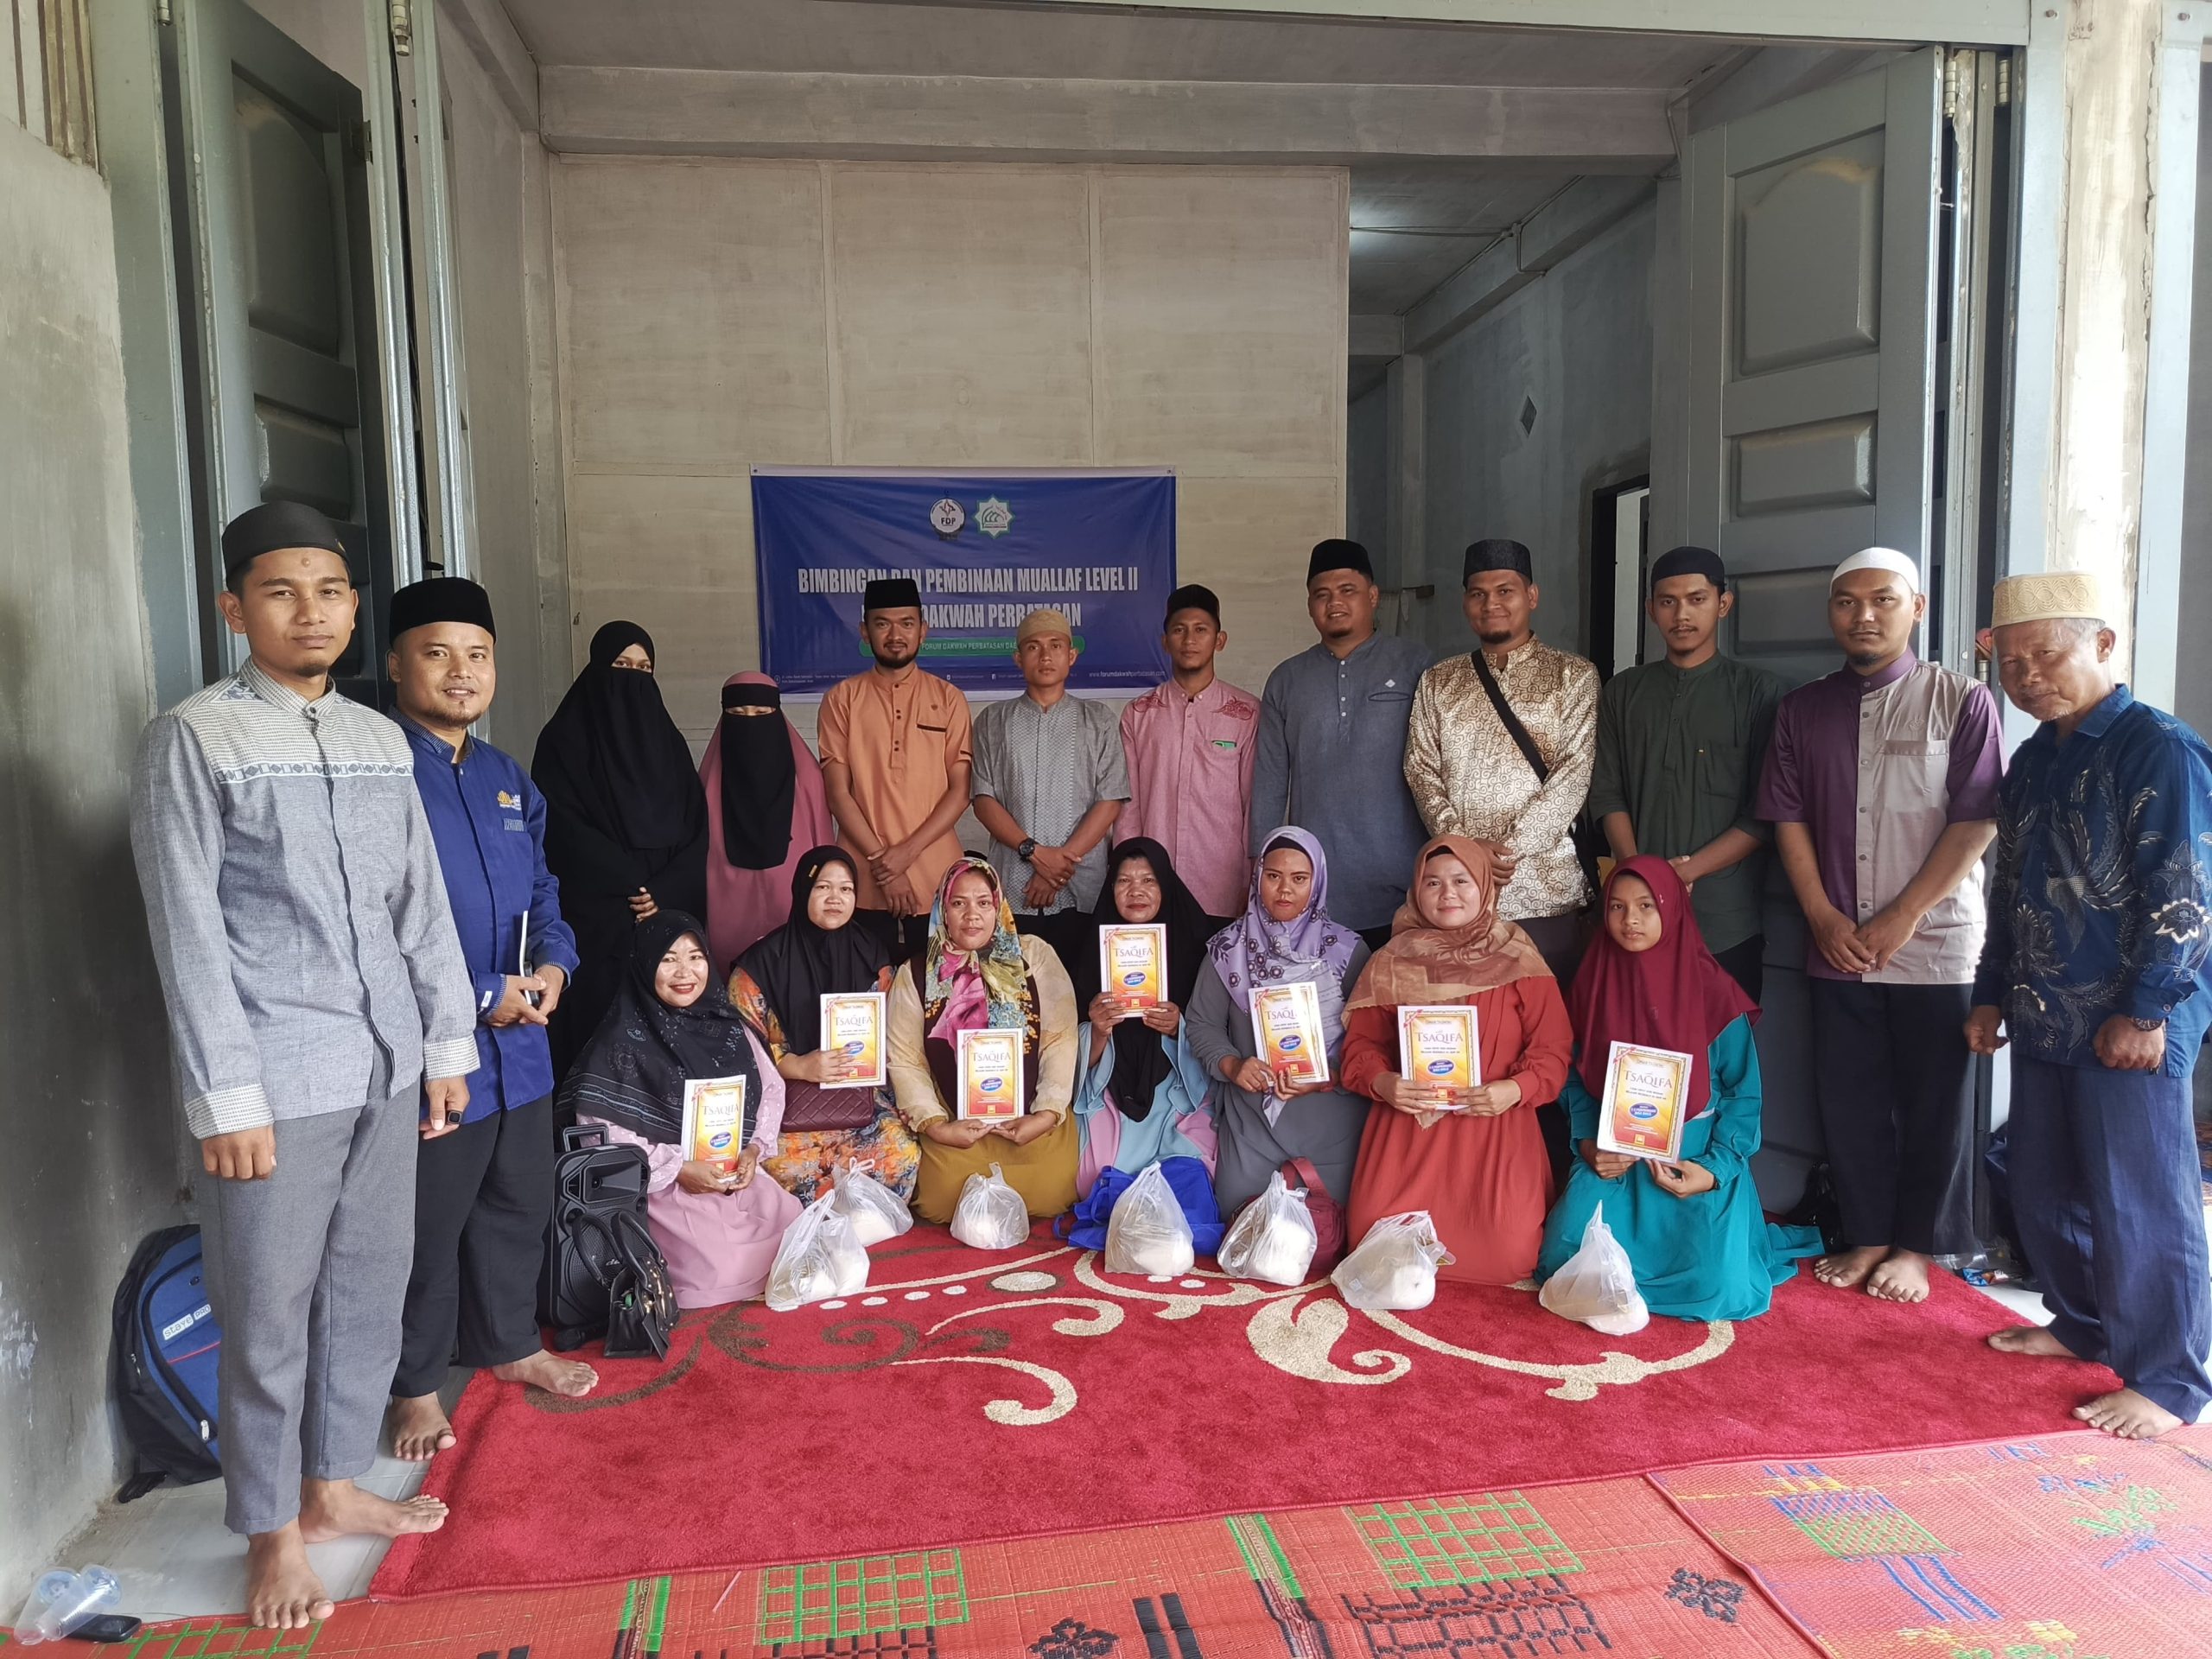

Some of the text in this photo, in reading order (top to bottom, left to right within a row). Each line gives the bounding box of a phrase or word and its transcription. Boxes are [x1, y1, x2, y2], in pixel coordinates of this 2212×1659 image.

[925, 568, 1014, 594] PEMBINAAN
[1017, 567, 1082, 592] MUALLAF
[1085, 567, 1125, 591] LEVEL
[1128, 566, 1138, 591] II
[920, 602, 1082, 628] DAKWAH PERBAN
[1113, 947, 1154, 958] TSAQIFA
[1264, 1009, 1307, 1020] TSAQI
[1415, 1032, 1464, 1045] TSAQIFA
[1624, 1070, 1673, 1089] TSAQIFA
[194, 1306, 211, 1318] PRO
